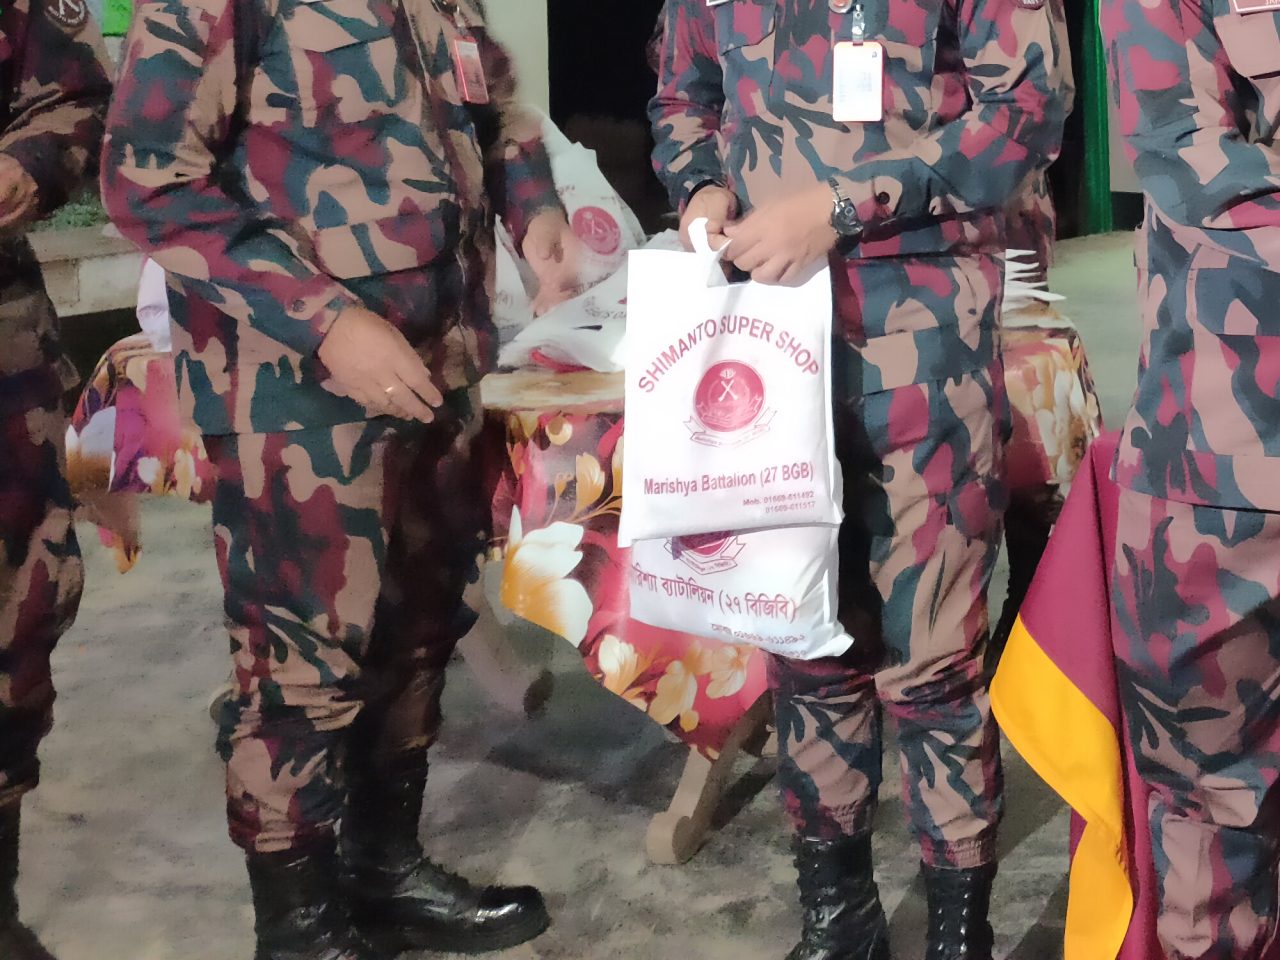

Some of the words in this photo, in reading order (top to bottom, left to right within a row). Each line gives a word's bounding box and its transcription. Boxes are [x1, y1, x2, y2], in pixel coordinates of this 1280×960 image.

[638, 319, 718, 393] SHIMANTO
[719, 314, 774, 343] SUPER
[775, 330, 820, 376] SHOP
[644, 477, 698, 497] Marishya
[701, 472, 757, 492] Battalion
[760, 466, 778, 488] (27
[782, 461, 814, 483] BGB)
